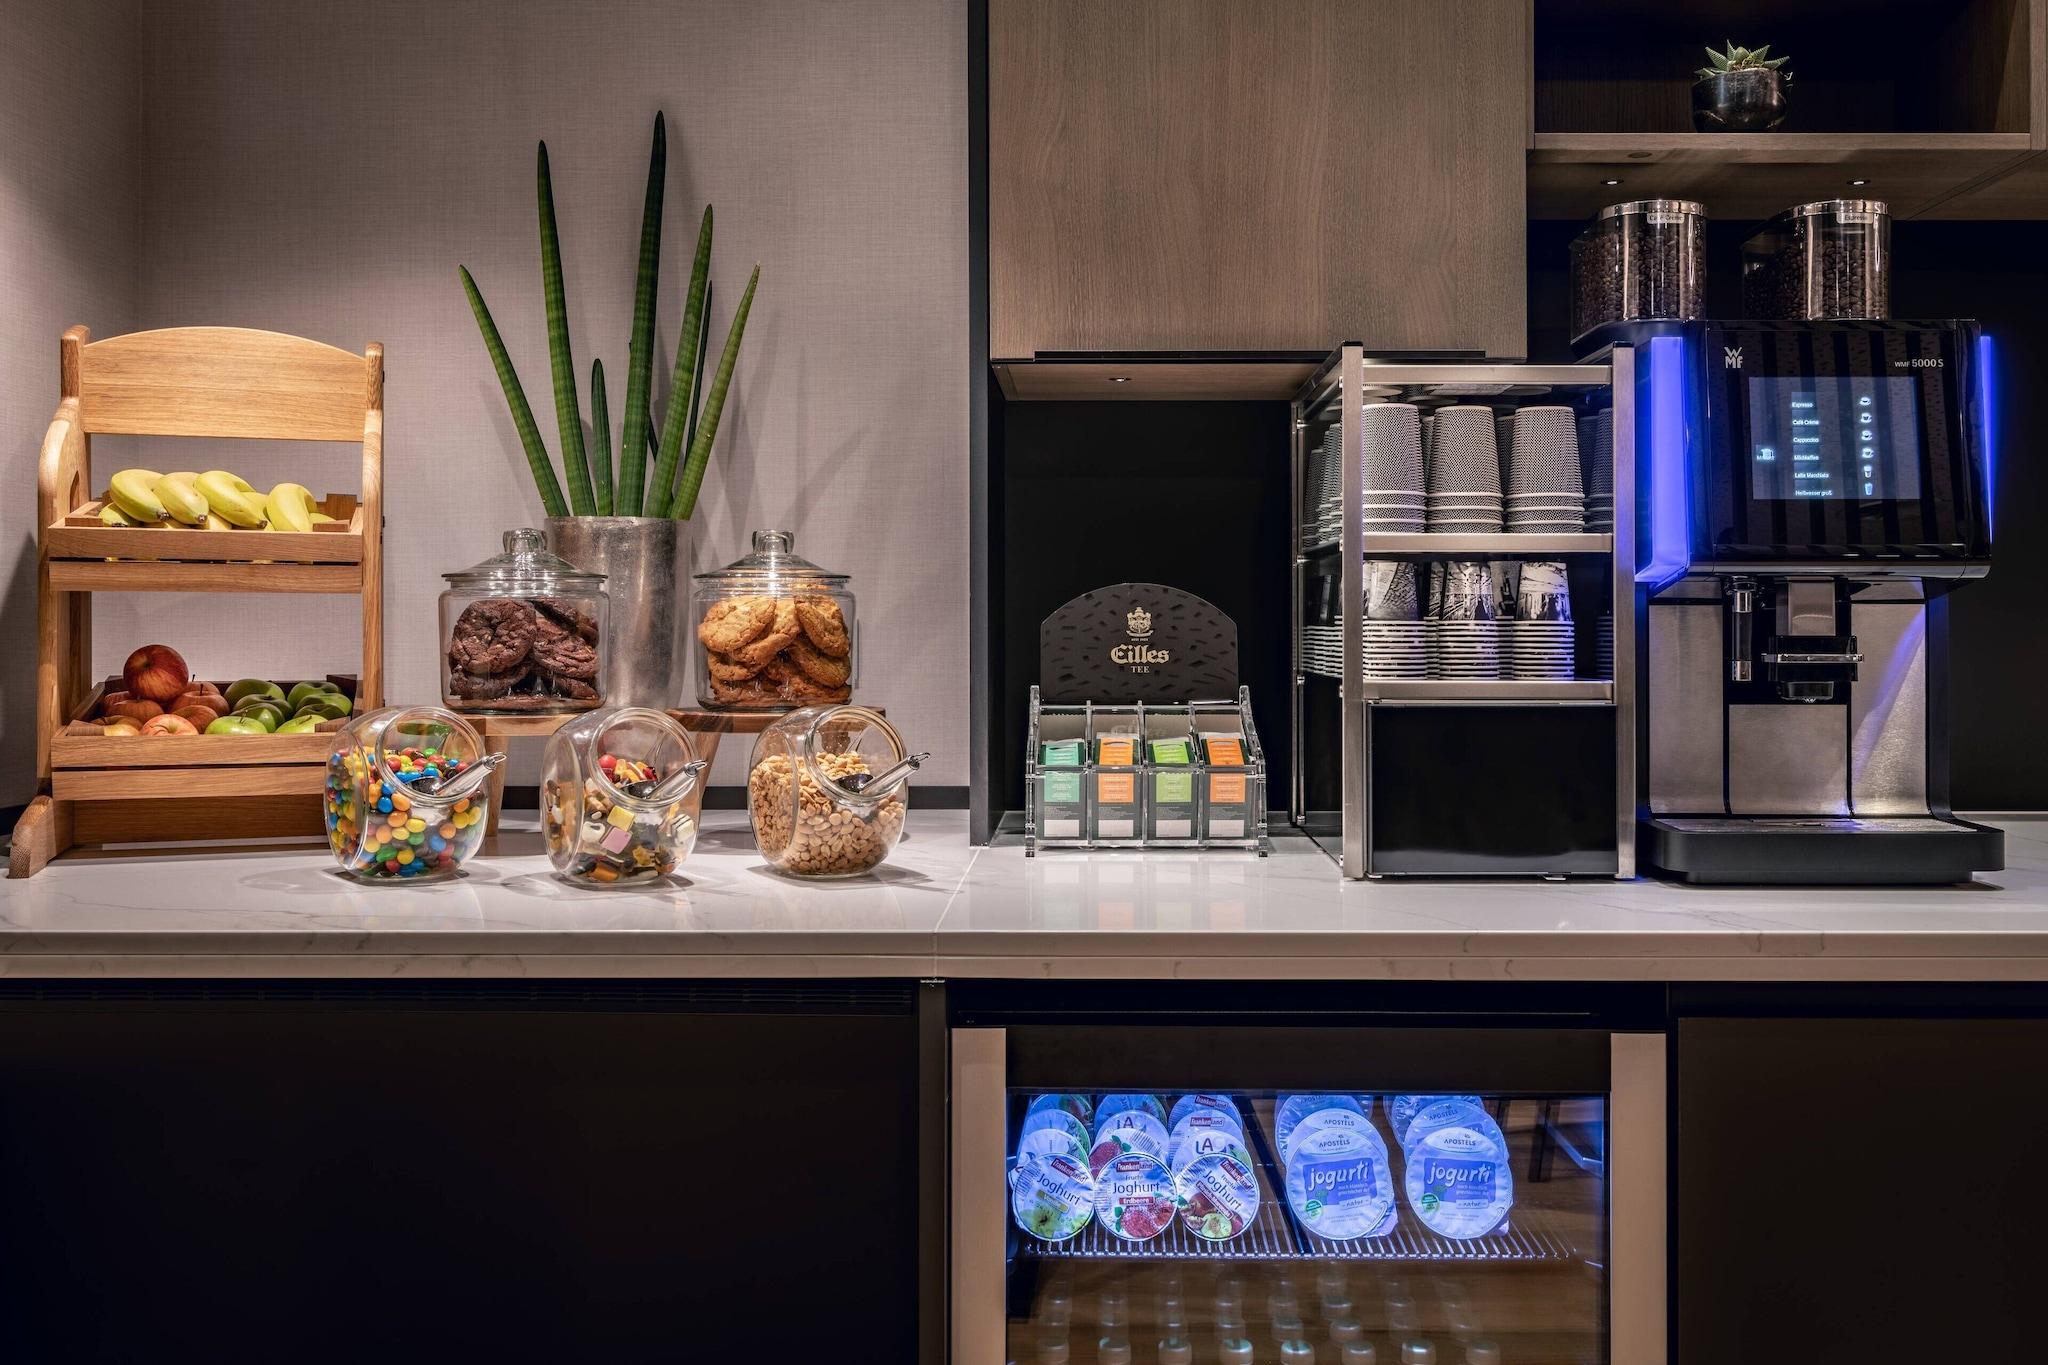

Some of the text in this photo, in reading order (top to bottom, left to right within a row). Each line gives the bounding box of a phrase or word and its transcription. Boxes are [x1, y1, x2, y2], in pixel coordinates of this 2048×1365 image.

[1911, 359, 1937, 367] 5000
[1110, 644, 1170, 664] Eilles
[1131, 665, 1150, 673] TEE
[1319, 1140, 1351, 1148] APOSTELS
[1444, 1138, 1476, 1146] APOSTELS
[1308, 1161, 1369, 1191] jogurti
[1427, 1162, 1491, 1187] jogurti
[1037, 1173, 1080, 1205] Joghurt
[1112, 1181, 1160, 1196] Joghurt
[1202, 1170, 1242, 1210] Joghurt
